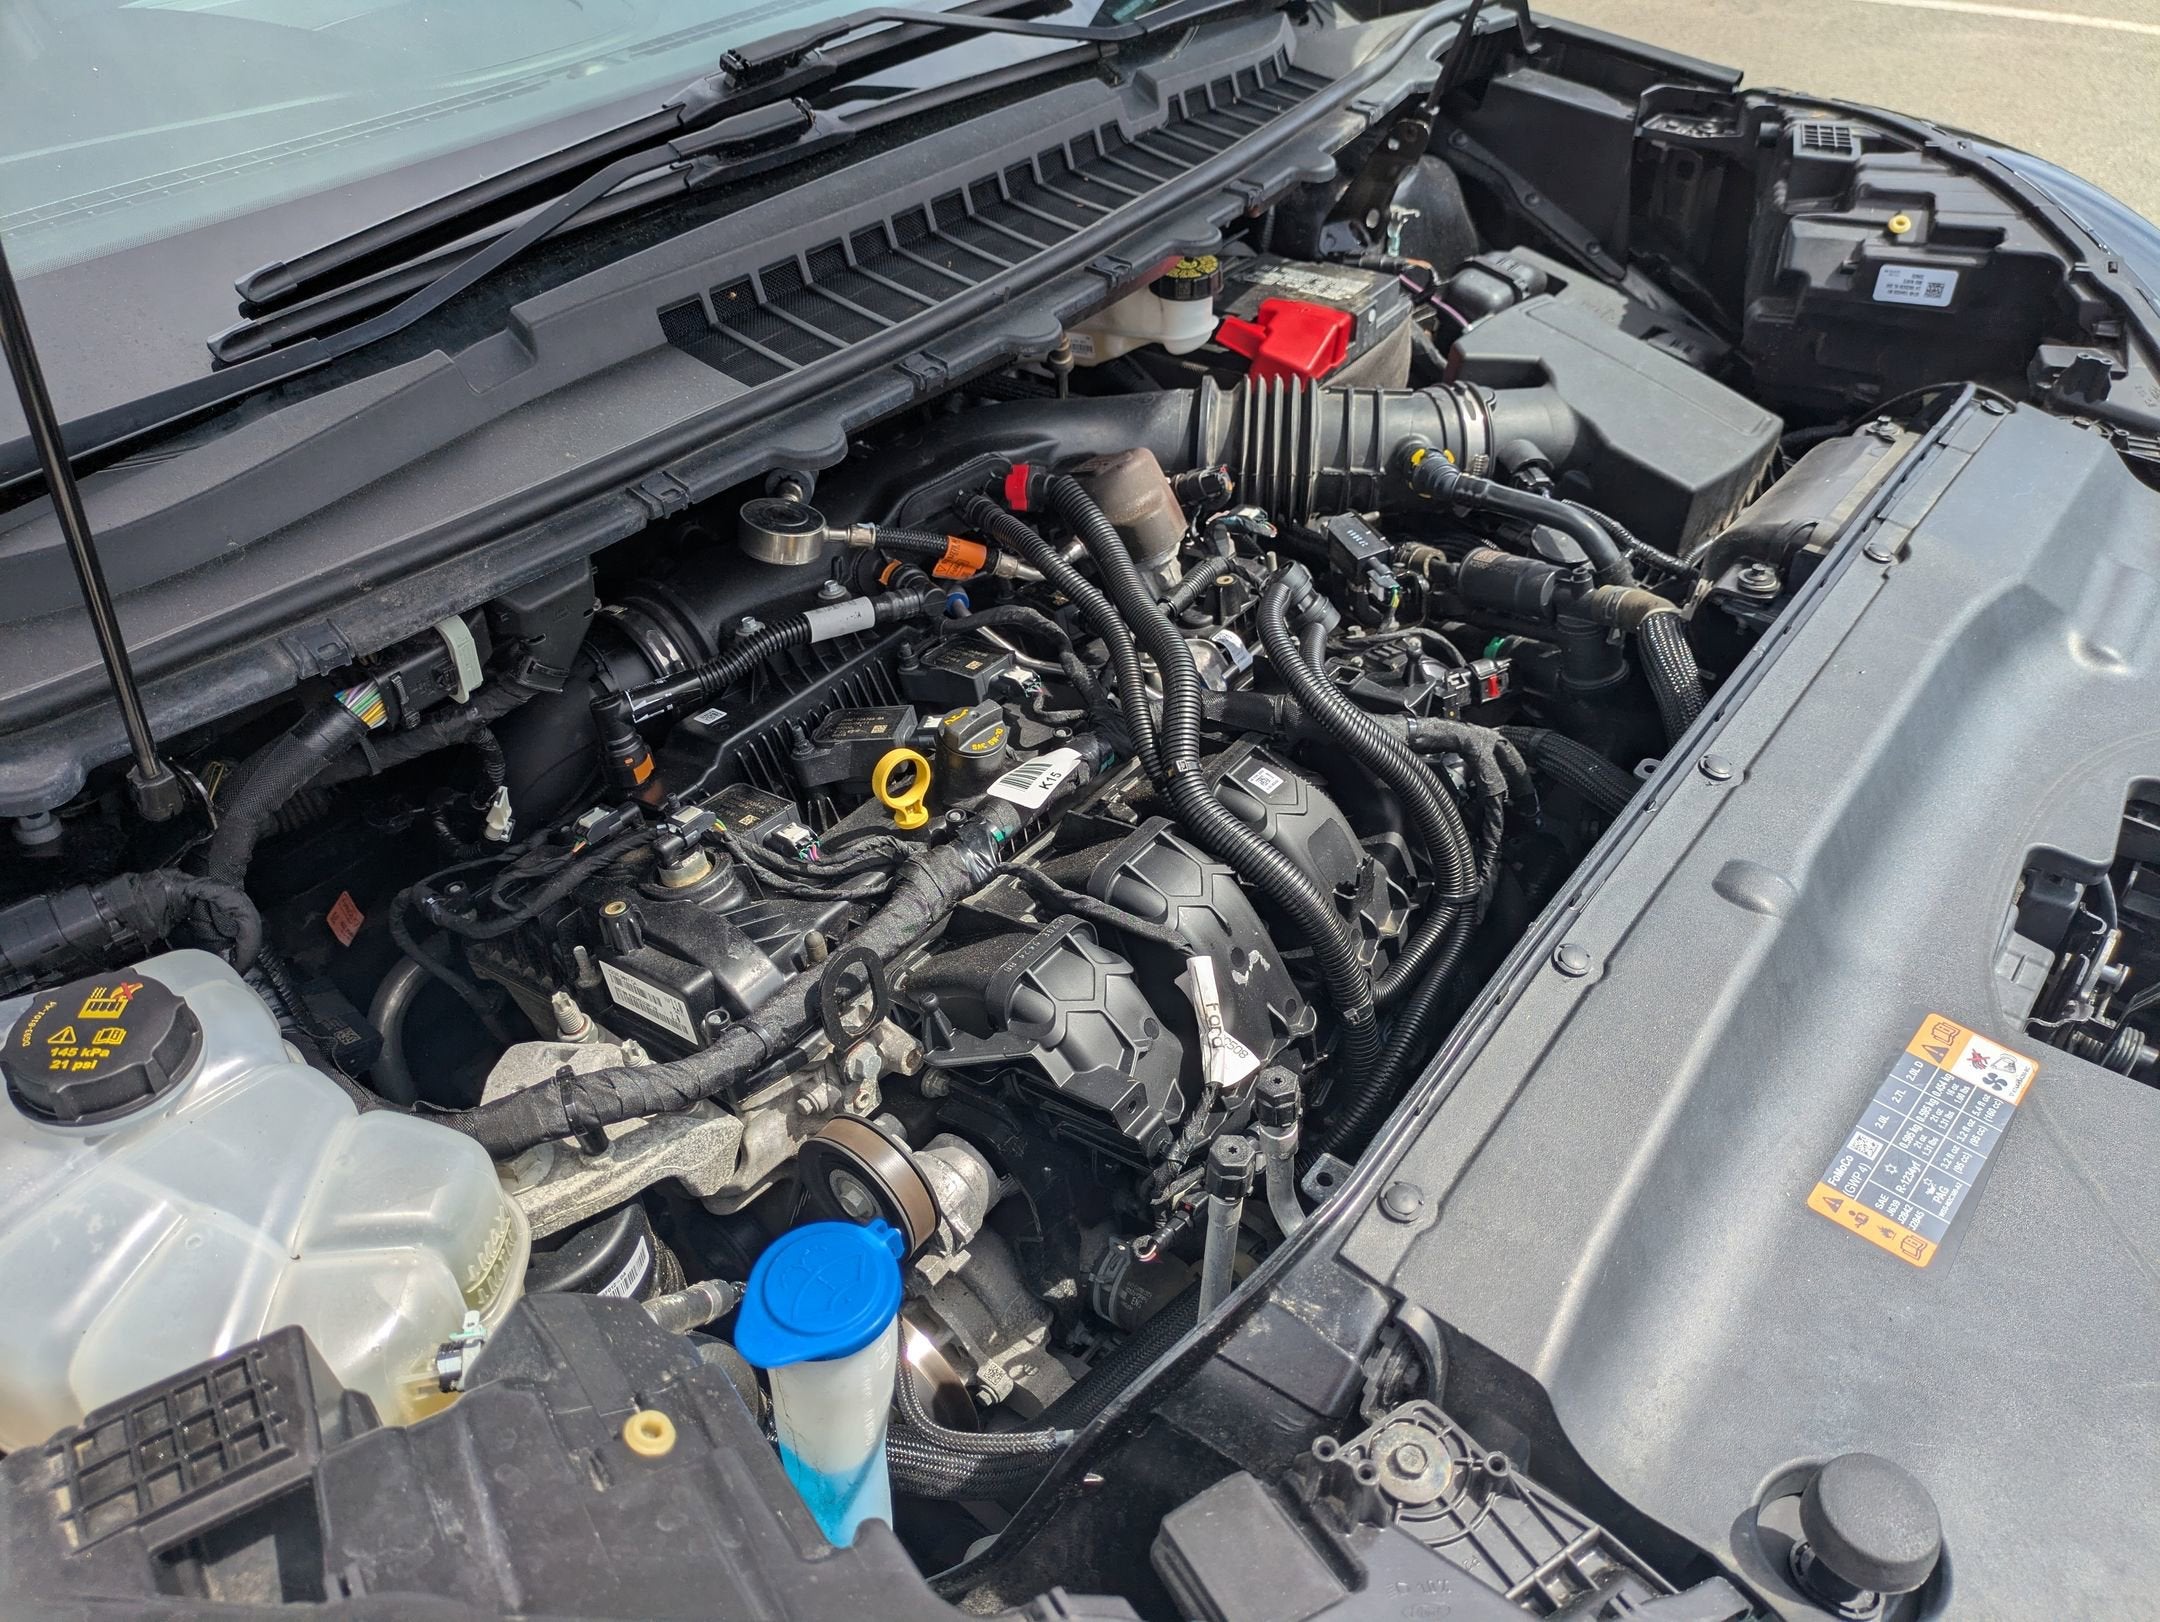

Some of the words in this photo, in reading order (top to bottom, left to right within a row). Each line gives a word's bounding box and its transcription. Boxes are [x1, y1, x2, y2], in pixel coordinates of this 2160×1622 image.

[1038, 771, 1062, 790] K15
[50, 1047, 78, 1057] 145
[80, 1047, 110, 1058] kPa
[49, 1059, 69, 1070] 21
[71, 1059, 98, 1072] psi
[1906, 1068, 1920, 1081] 2.0L
[1892, 1089, 1907, 1104] 2.7L
[1875, 1115, 1890, 1129] 2.0L
[1828, 1155, 1854, 1186] FoMoCo
[1895, 1160, 1921, 1194] R-1234yf
[1842, 1171, 1862, 1198] (GWP
[1859, 1163, 1872, 1174] 4)
[1875, 1194, 1889, 1209] SAE
[1932, 1185, 1949, 1204] PAG
[1886, 1200, 1901, 1216] J639
[1898, 1204, 1913, 1225] J2842
[1909, 1210, 1925, 1231] J2845
